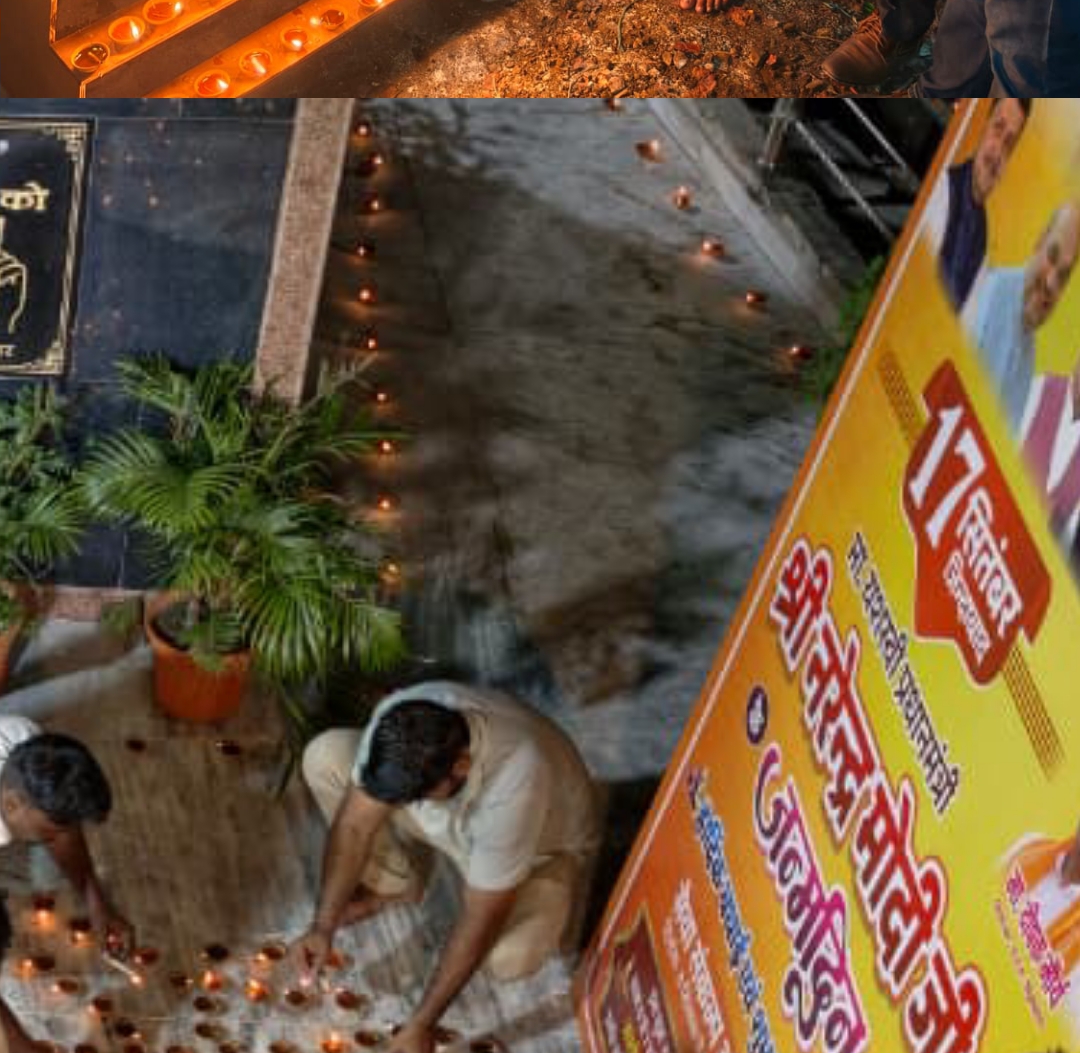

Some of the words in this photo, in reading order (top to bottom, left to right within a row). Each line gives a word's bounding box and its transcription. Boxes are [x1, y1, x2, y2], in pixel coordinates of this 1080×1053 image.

[909, 405, 986, 550] 17
[772, 542, 829, 666] श्री
[856, 780, 941, 992] मोदी
[894, 665, 959, 816] प्रधानमंत्री
